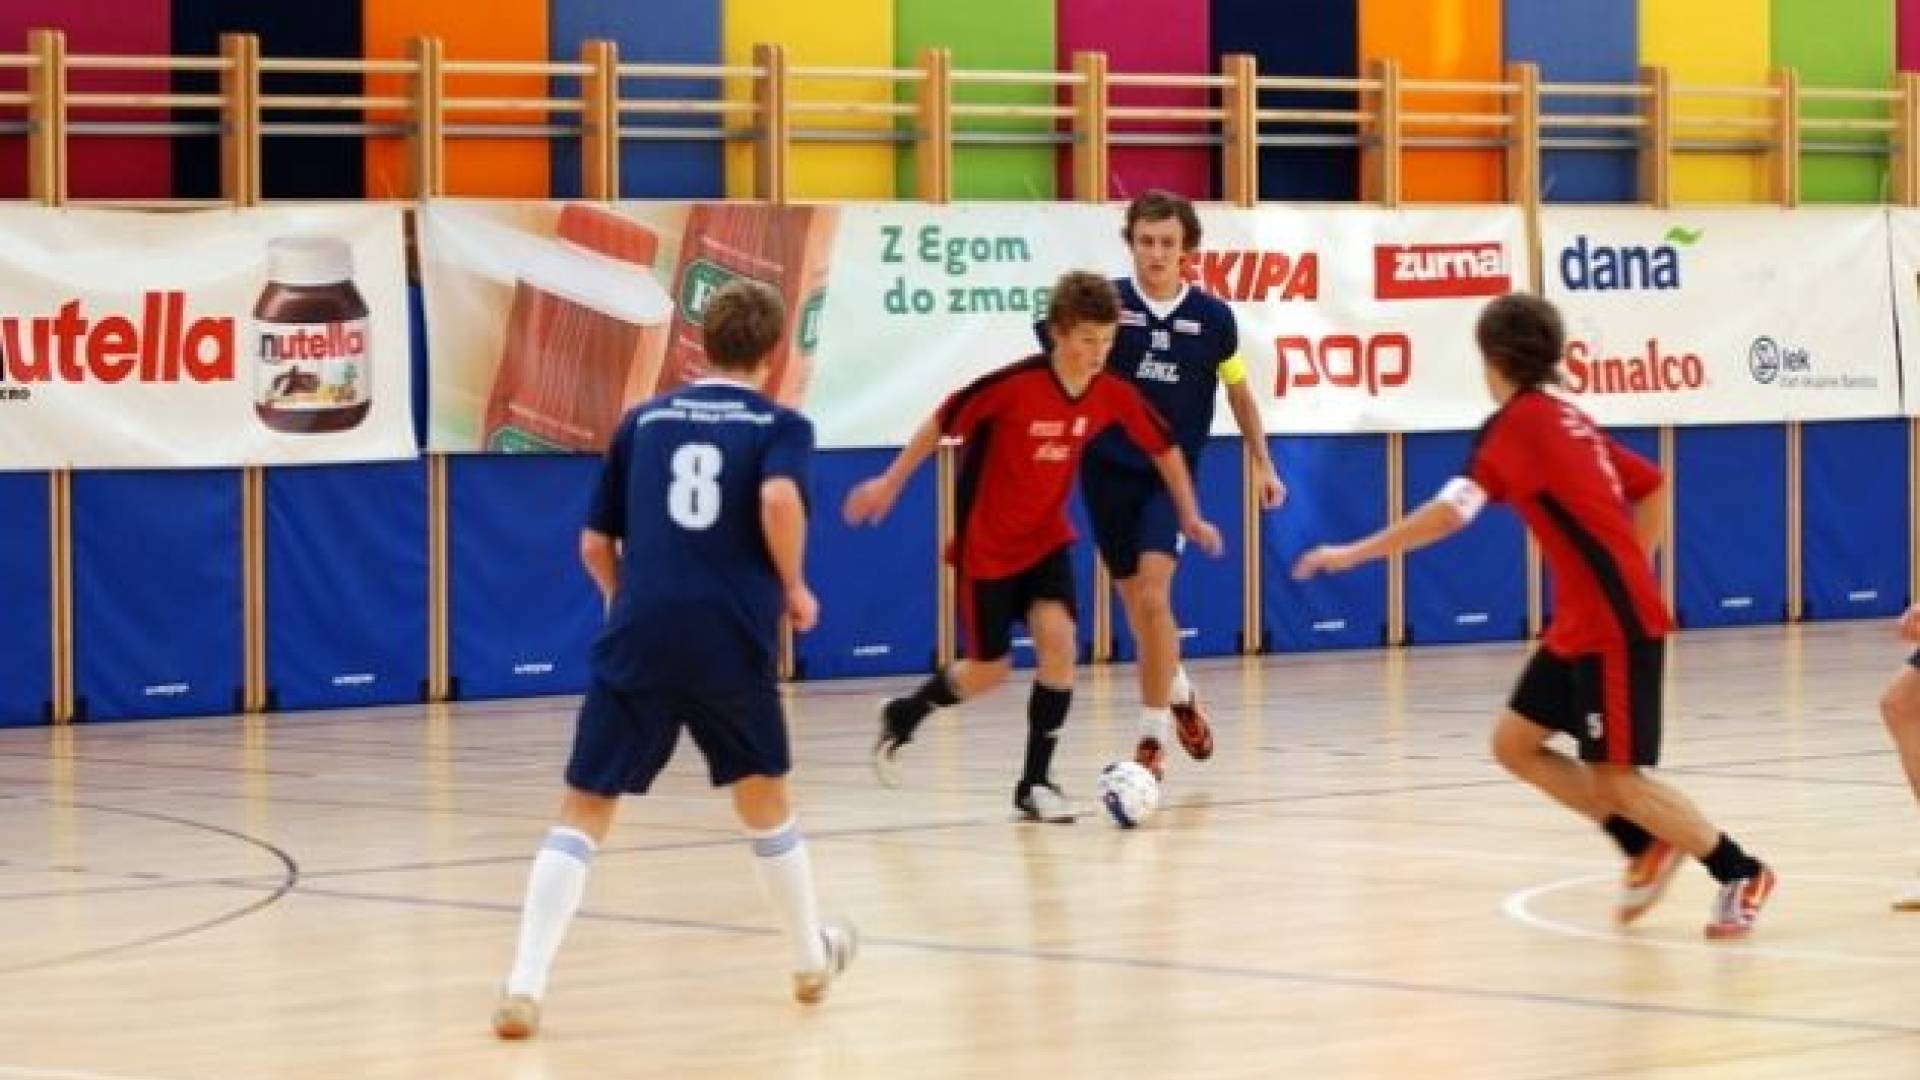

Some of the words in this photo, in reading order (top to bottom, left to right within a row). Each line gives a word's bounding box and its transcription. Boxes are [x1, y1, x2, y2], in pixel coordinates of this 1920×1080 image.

[879, 225, 904, 262] Z
[918, 225, 1031, 274] Egom
[1560, 235, 1680, 290] dana
[884, 276, 938, 314] do
[0, 291, 235, 384] utella
[261, 321, 364, 362] nutella
[1274, 332, 1412, 397] pop
[1566, 337, 1704, 394] Sinalco
[667, 442, 723, 530] 8
